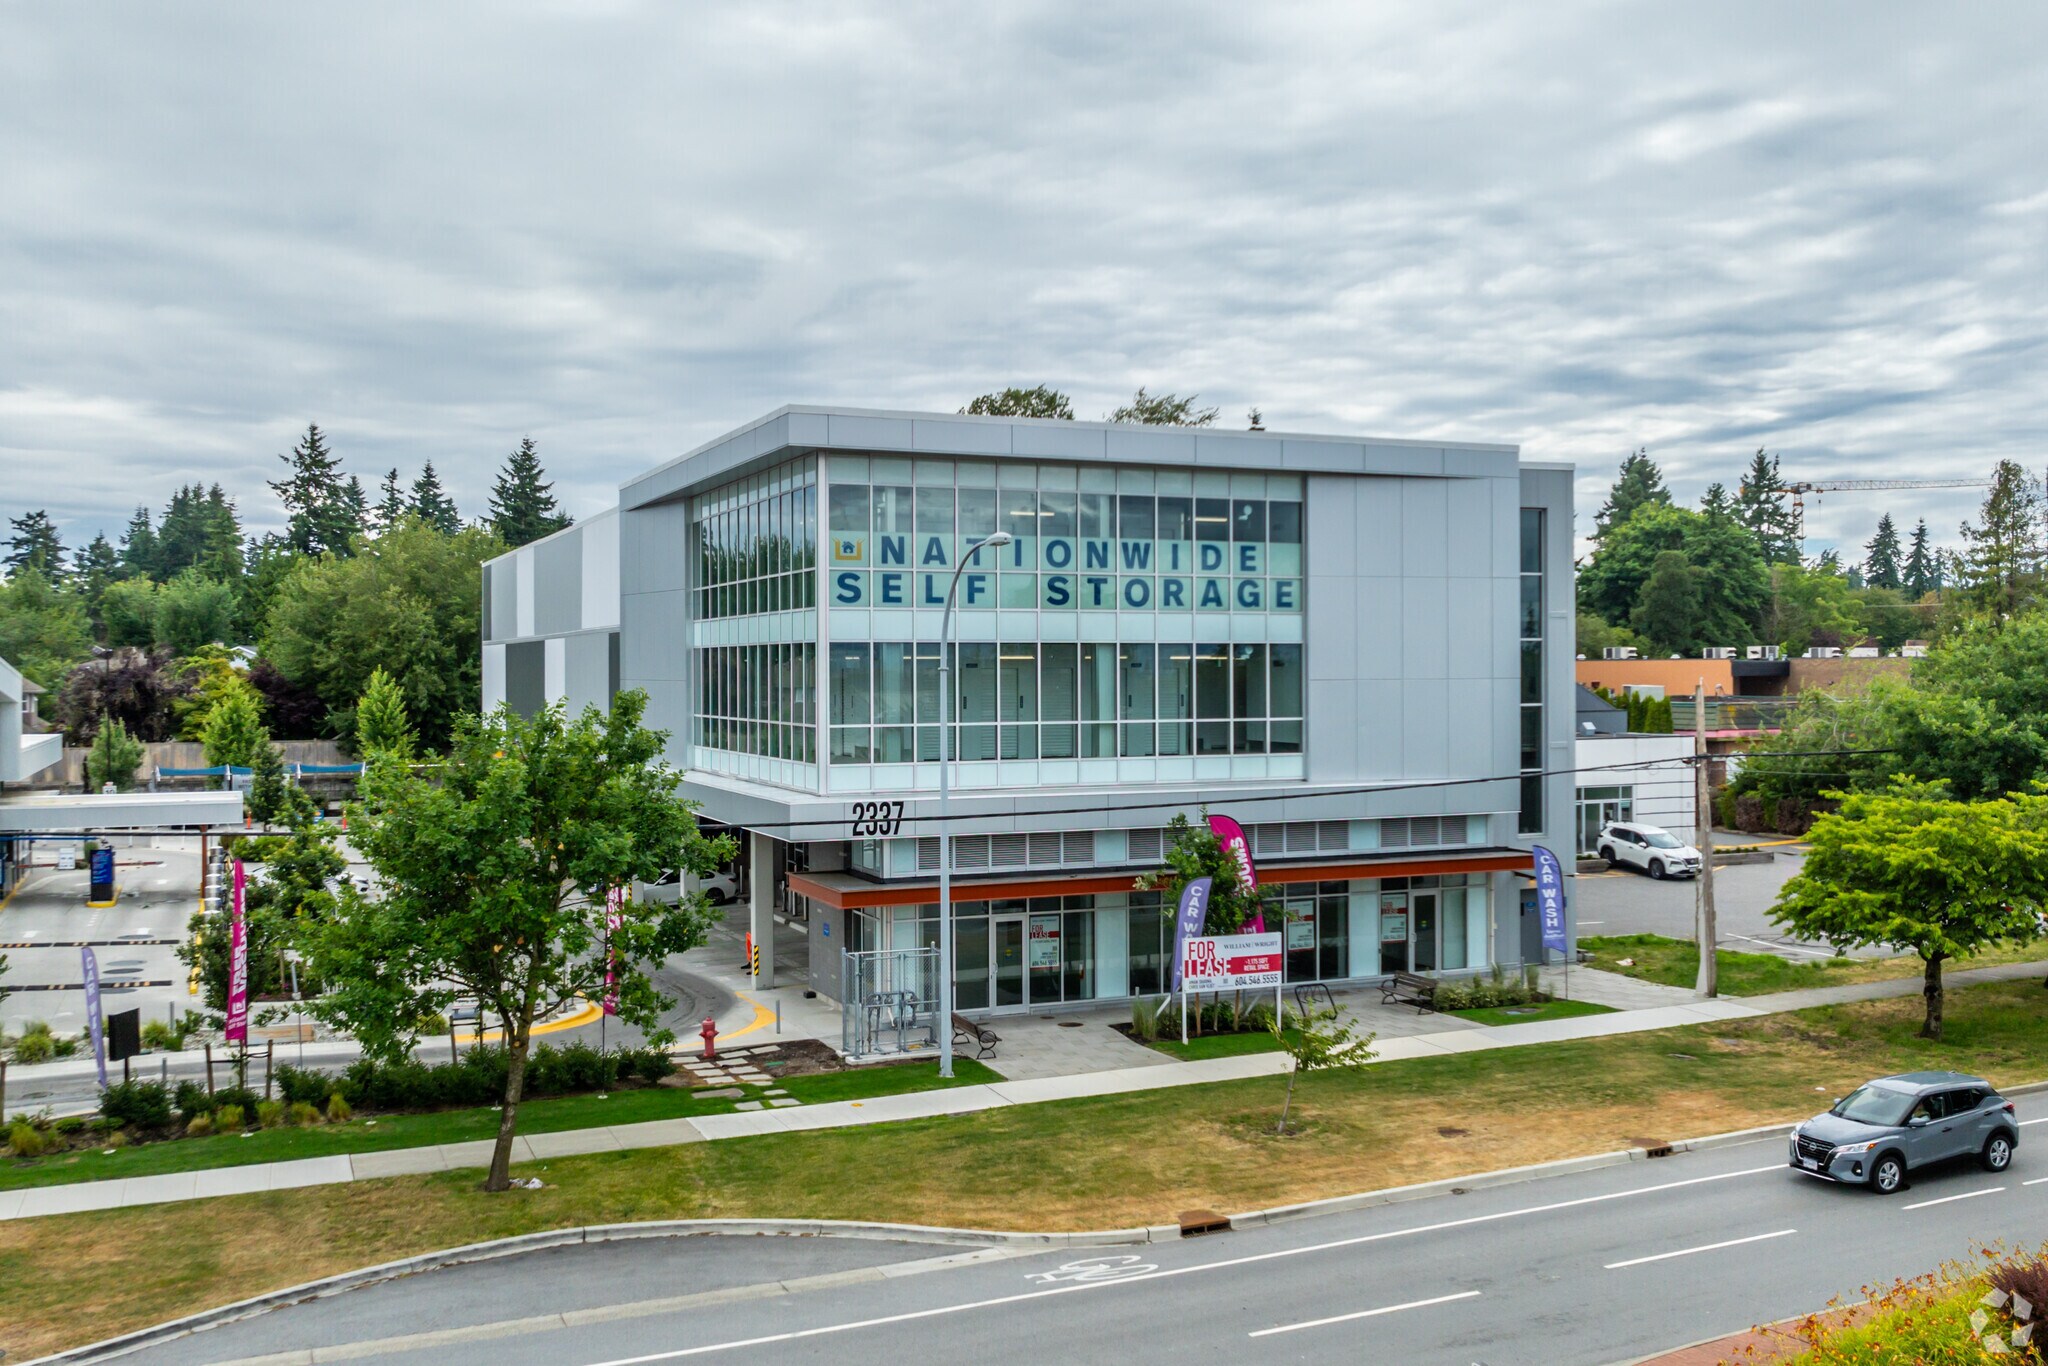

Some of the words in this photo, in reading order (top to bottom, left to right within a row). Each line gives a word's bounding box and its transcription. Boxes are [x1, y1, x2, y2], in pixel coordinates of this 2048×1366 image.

[881, 535, 1257, 572] NATIONWIDE
[836, 572, 986, 604] SELF
[1046, 575, 1293, 609] STORAGE
[852, 801, 904, 837] 2337
[1540, 855, 1554, 884] CAR
[1187, 886, 1203, 918] CAR
[1542, 888, 1559, 928] WASH
[1188, 940, 1216, 960] FOR
[1187, 958, 1231, 977] LEASE
